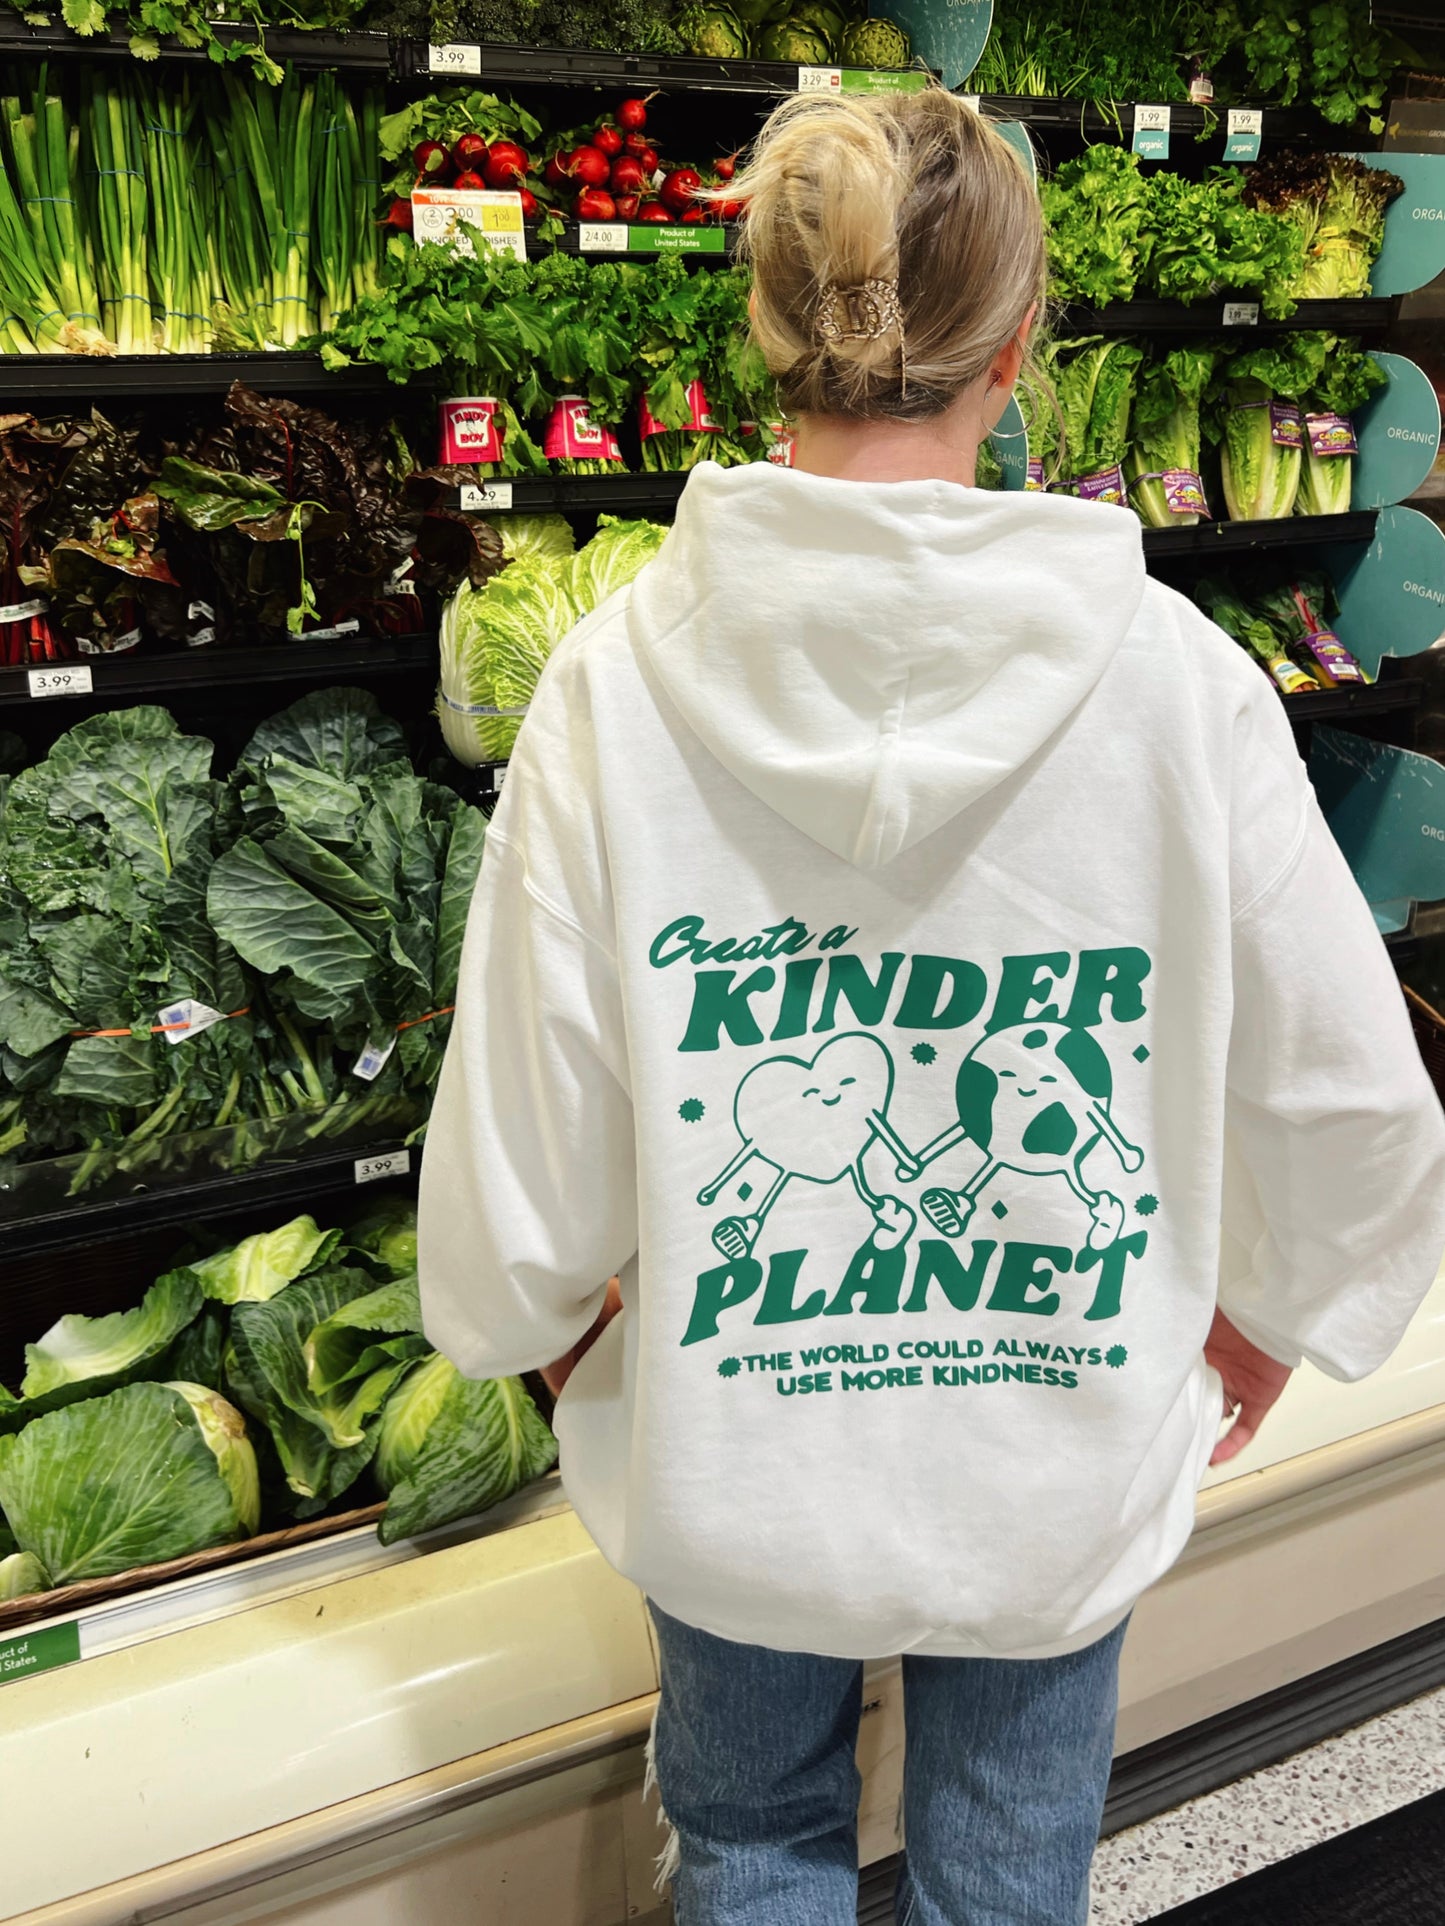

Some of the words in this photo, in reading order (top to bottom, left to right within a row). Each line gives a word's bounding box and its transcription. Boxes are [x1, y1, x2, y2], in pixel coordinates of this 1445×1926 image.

[436, 51, 465, 63] 3.99
[1140, 113, 1160, 122] 1.99
[1232, 115, 1251, 124] 1.99
[1139, 140, 1163, 151] organic
[1231, 143, 1254, 154] organic
[1412, 208, 1445, 220] ORGA
[585, 231, 612, 242] 2/4.00
[660, 228, 686, 237] Product
[654, 239, 678, 247] United
[679, 239, 700, 247] States
[454, 411, 487, 424] ANDY
[460, 433, 484, 443] BOY
[1387, 427, 1435, 445] ORGANIC
[37, 675, 71, 688] 3.99
[649, 915, 818, 969] Create
[818, 925, 859, 951] a
[677, 946, 1152, 1052] KINDER
[361, 1160, 392, 1175] 3.99
[680, 1231, 1149, 1347] PLANET
[742, 1352, 793, 1373] THE
[800, 1344, 889, 1368] WORLD
[897, 1339, 984, 1359] COULD
[992, 1339, 1102, 1366] ALWAYS
[777, 1371, 833, 1396] USE
[841, 1365, 924, 1391] MORE
[932, 1363, 1079, 1389] KINDNESS
[17, 1641, 29, 1654] of
[4, 1656, 38, 1671] States
